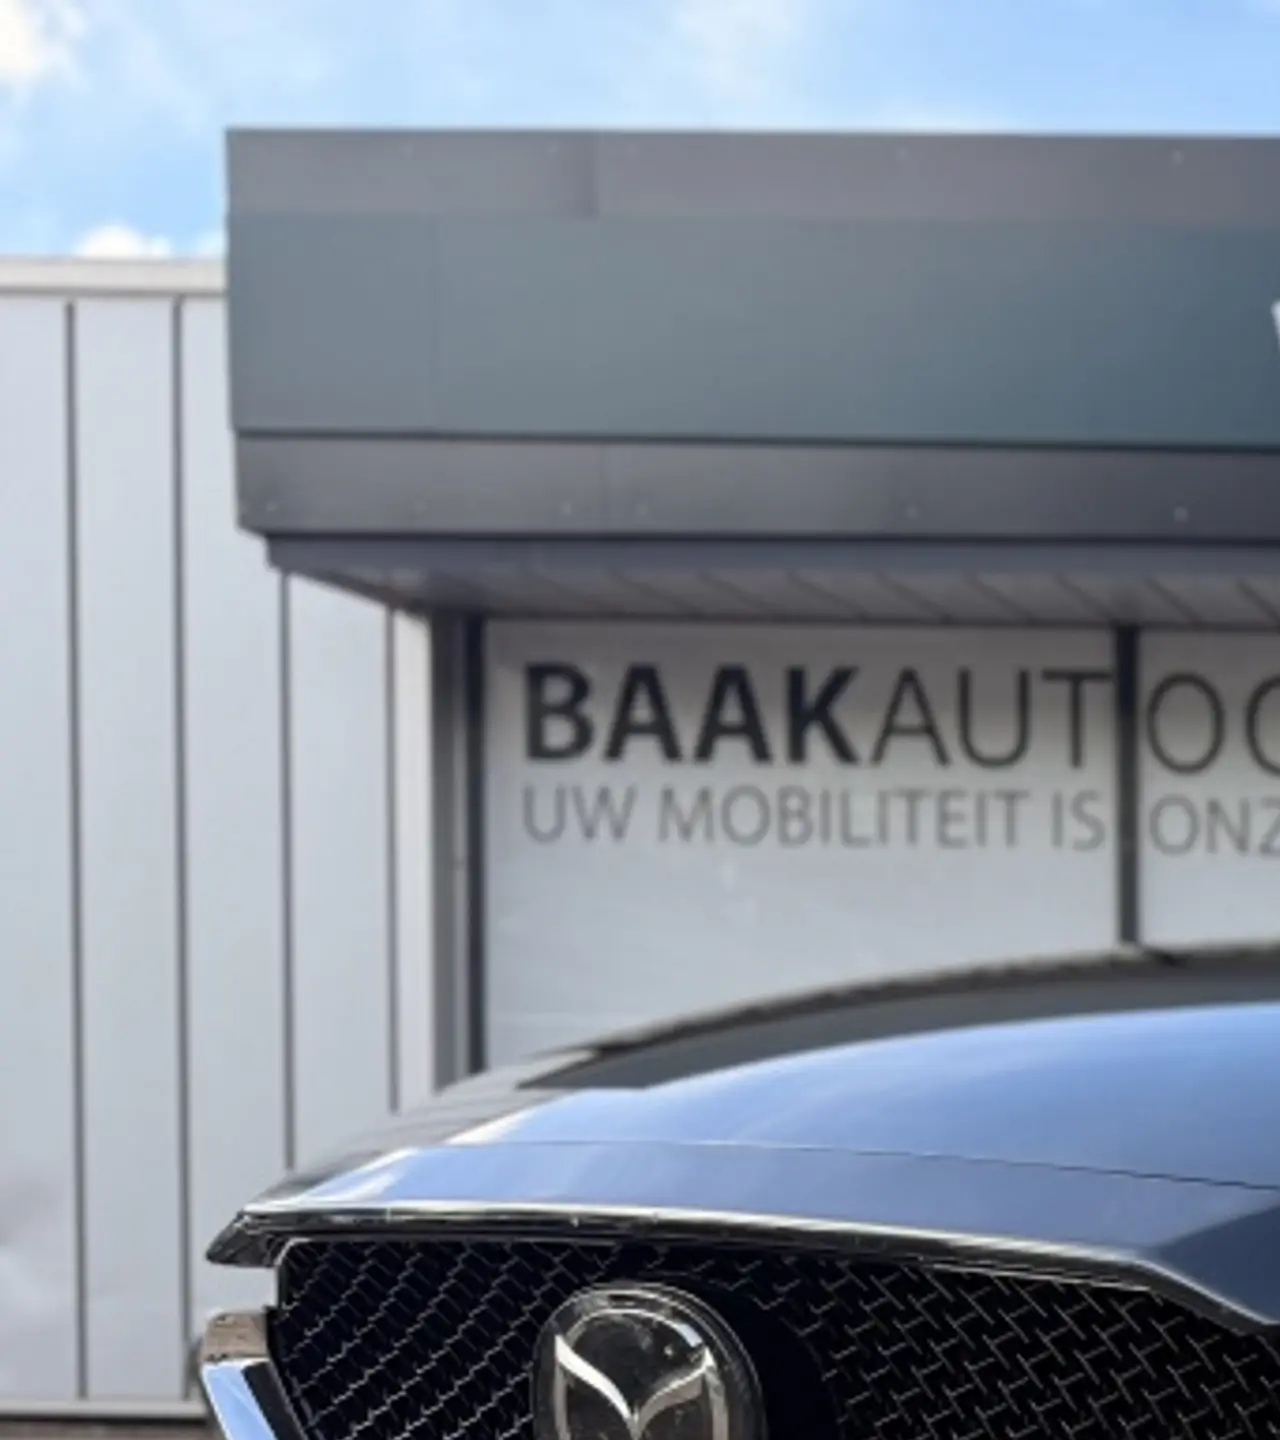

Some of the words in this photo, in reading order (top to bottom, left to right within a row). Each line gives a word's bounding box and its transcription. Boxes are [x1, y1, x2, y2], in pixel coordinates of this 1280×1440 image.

[521, 783, 640, 846] UW
[655, 784, 1031, 850] MOBILITEIT
[1048, 790, 1107, 853] IS
